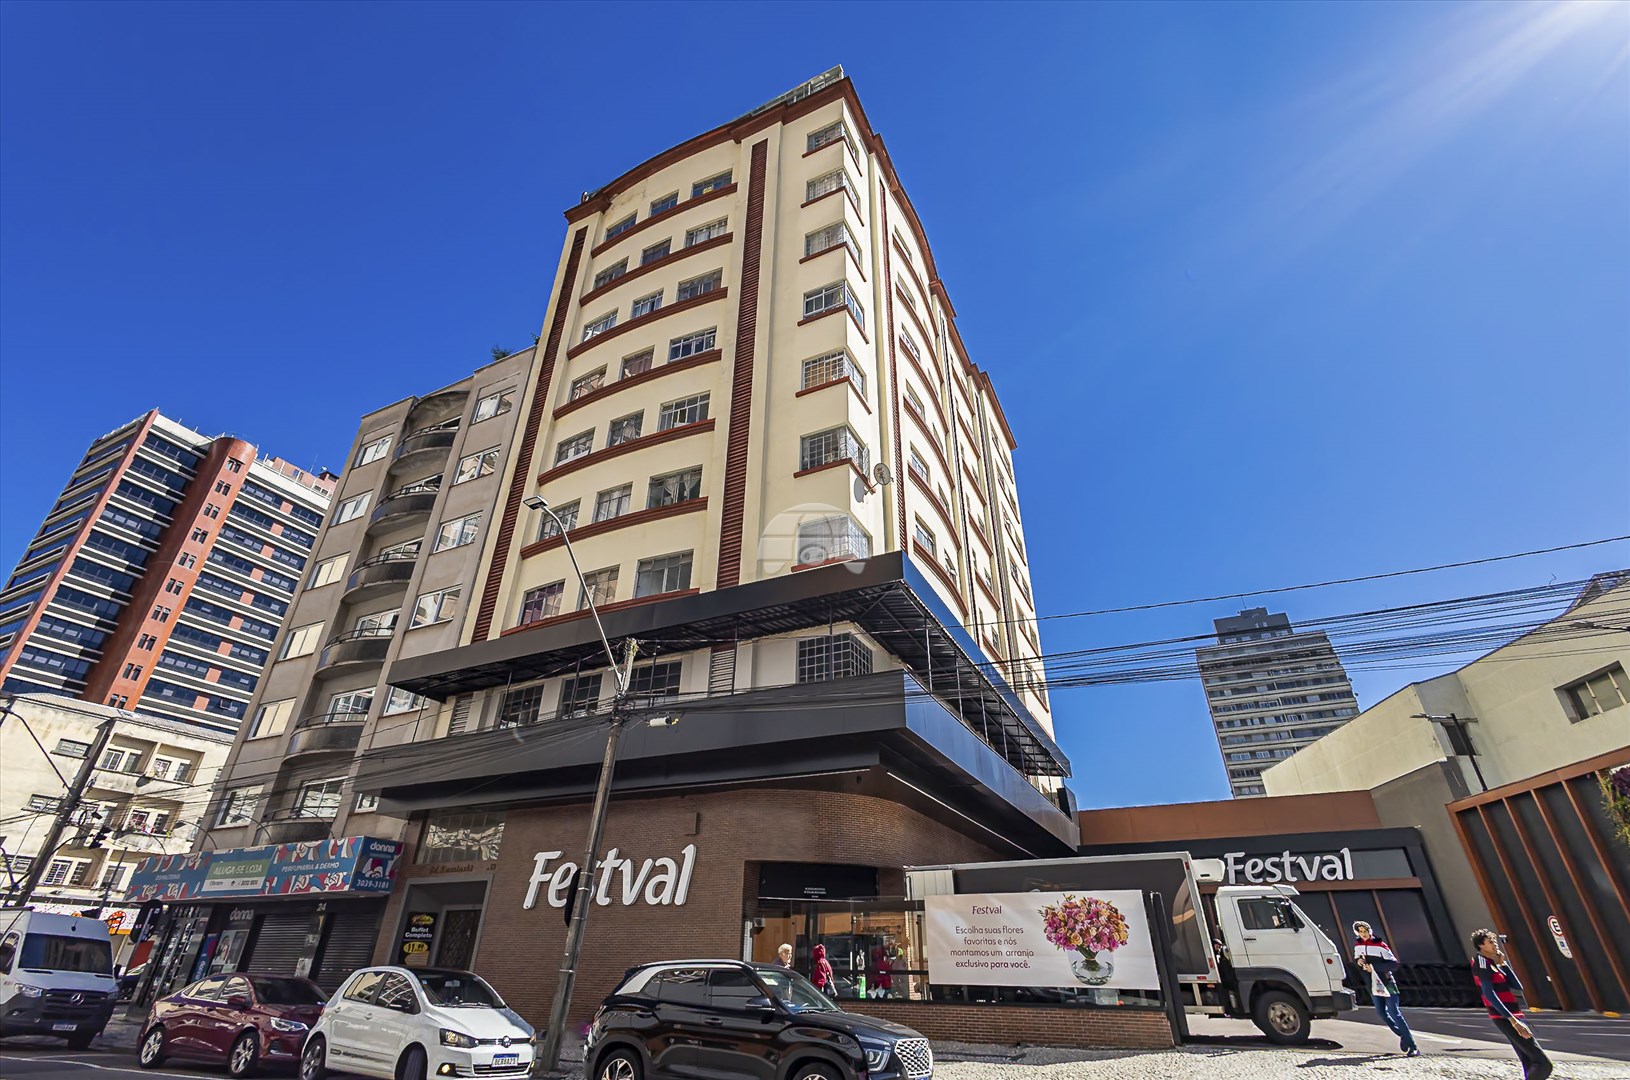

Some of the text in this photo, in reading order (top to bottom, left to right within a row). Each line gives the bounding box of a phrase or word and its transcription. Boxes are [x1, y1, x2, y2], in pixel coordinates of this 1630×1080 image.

[370, 841, 395, 853] donna
[213, 864, 263, 876] ALUGA-SE LOJA
[281, 864, 314, 873] PERFUMARIA
[319, 861, 340, 870] DERMO
[1223, 847, 1354, 885] Festval
[522, 843, 697, 910] Fetval
[316, 902, 327, 912] 24
[972, 905, 1002, 915] Festval
[229, 908, 254, 921] donna
[955, 926, 984, 934] Escolha
[1002, 925, 1024, 934] flores
[1551, 920, 1562, 932] E
[963, 937, 996, 945] favoritas
[1003, 936, 1017, 945] nós
[1005, 949, 1034, 958] arranjo
[955, 959, 1031, 970] exclusivo para você.
